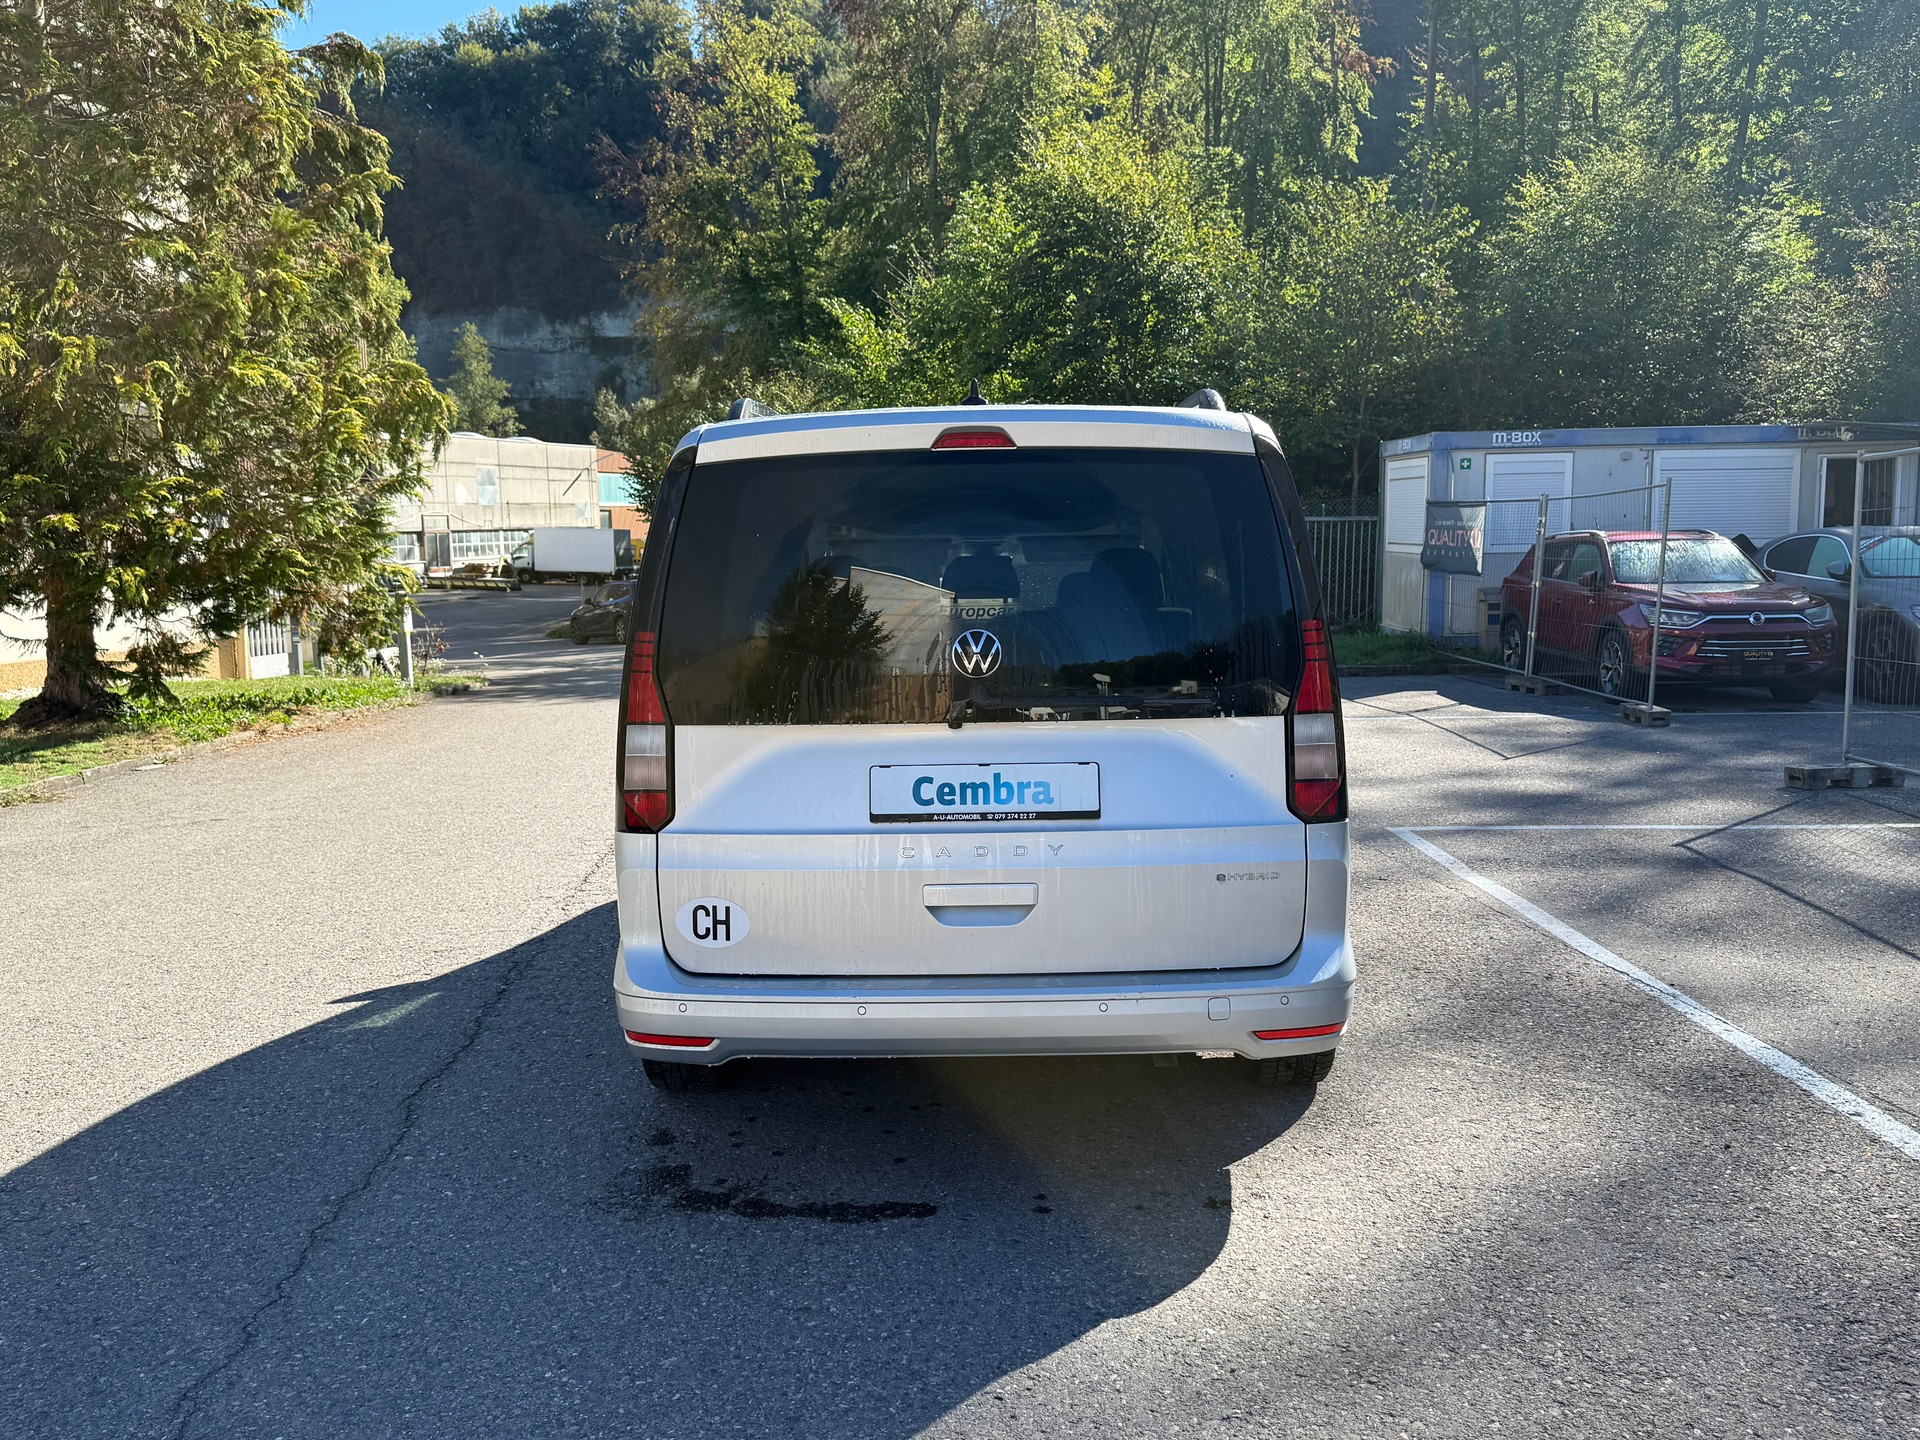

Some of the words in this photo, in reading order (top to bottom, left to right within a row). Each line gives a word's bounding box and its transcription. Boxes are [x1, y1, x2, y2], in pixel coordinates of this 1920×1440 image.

[912, 772, 1054, 806] Cembra
[899, 844, 1064, 859] CADDY
[692, 904, 731, 942] CH
